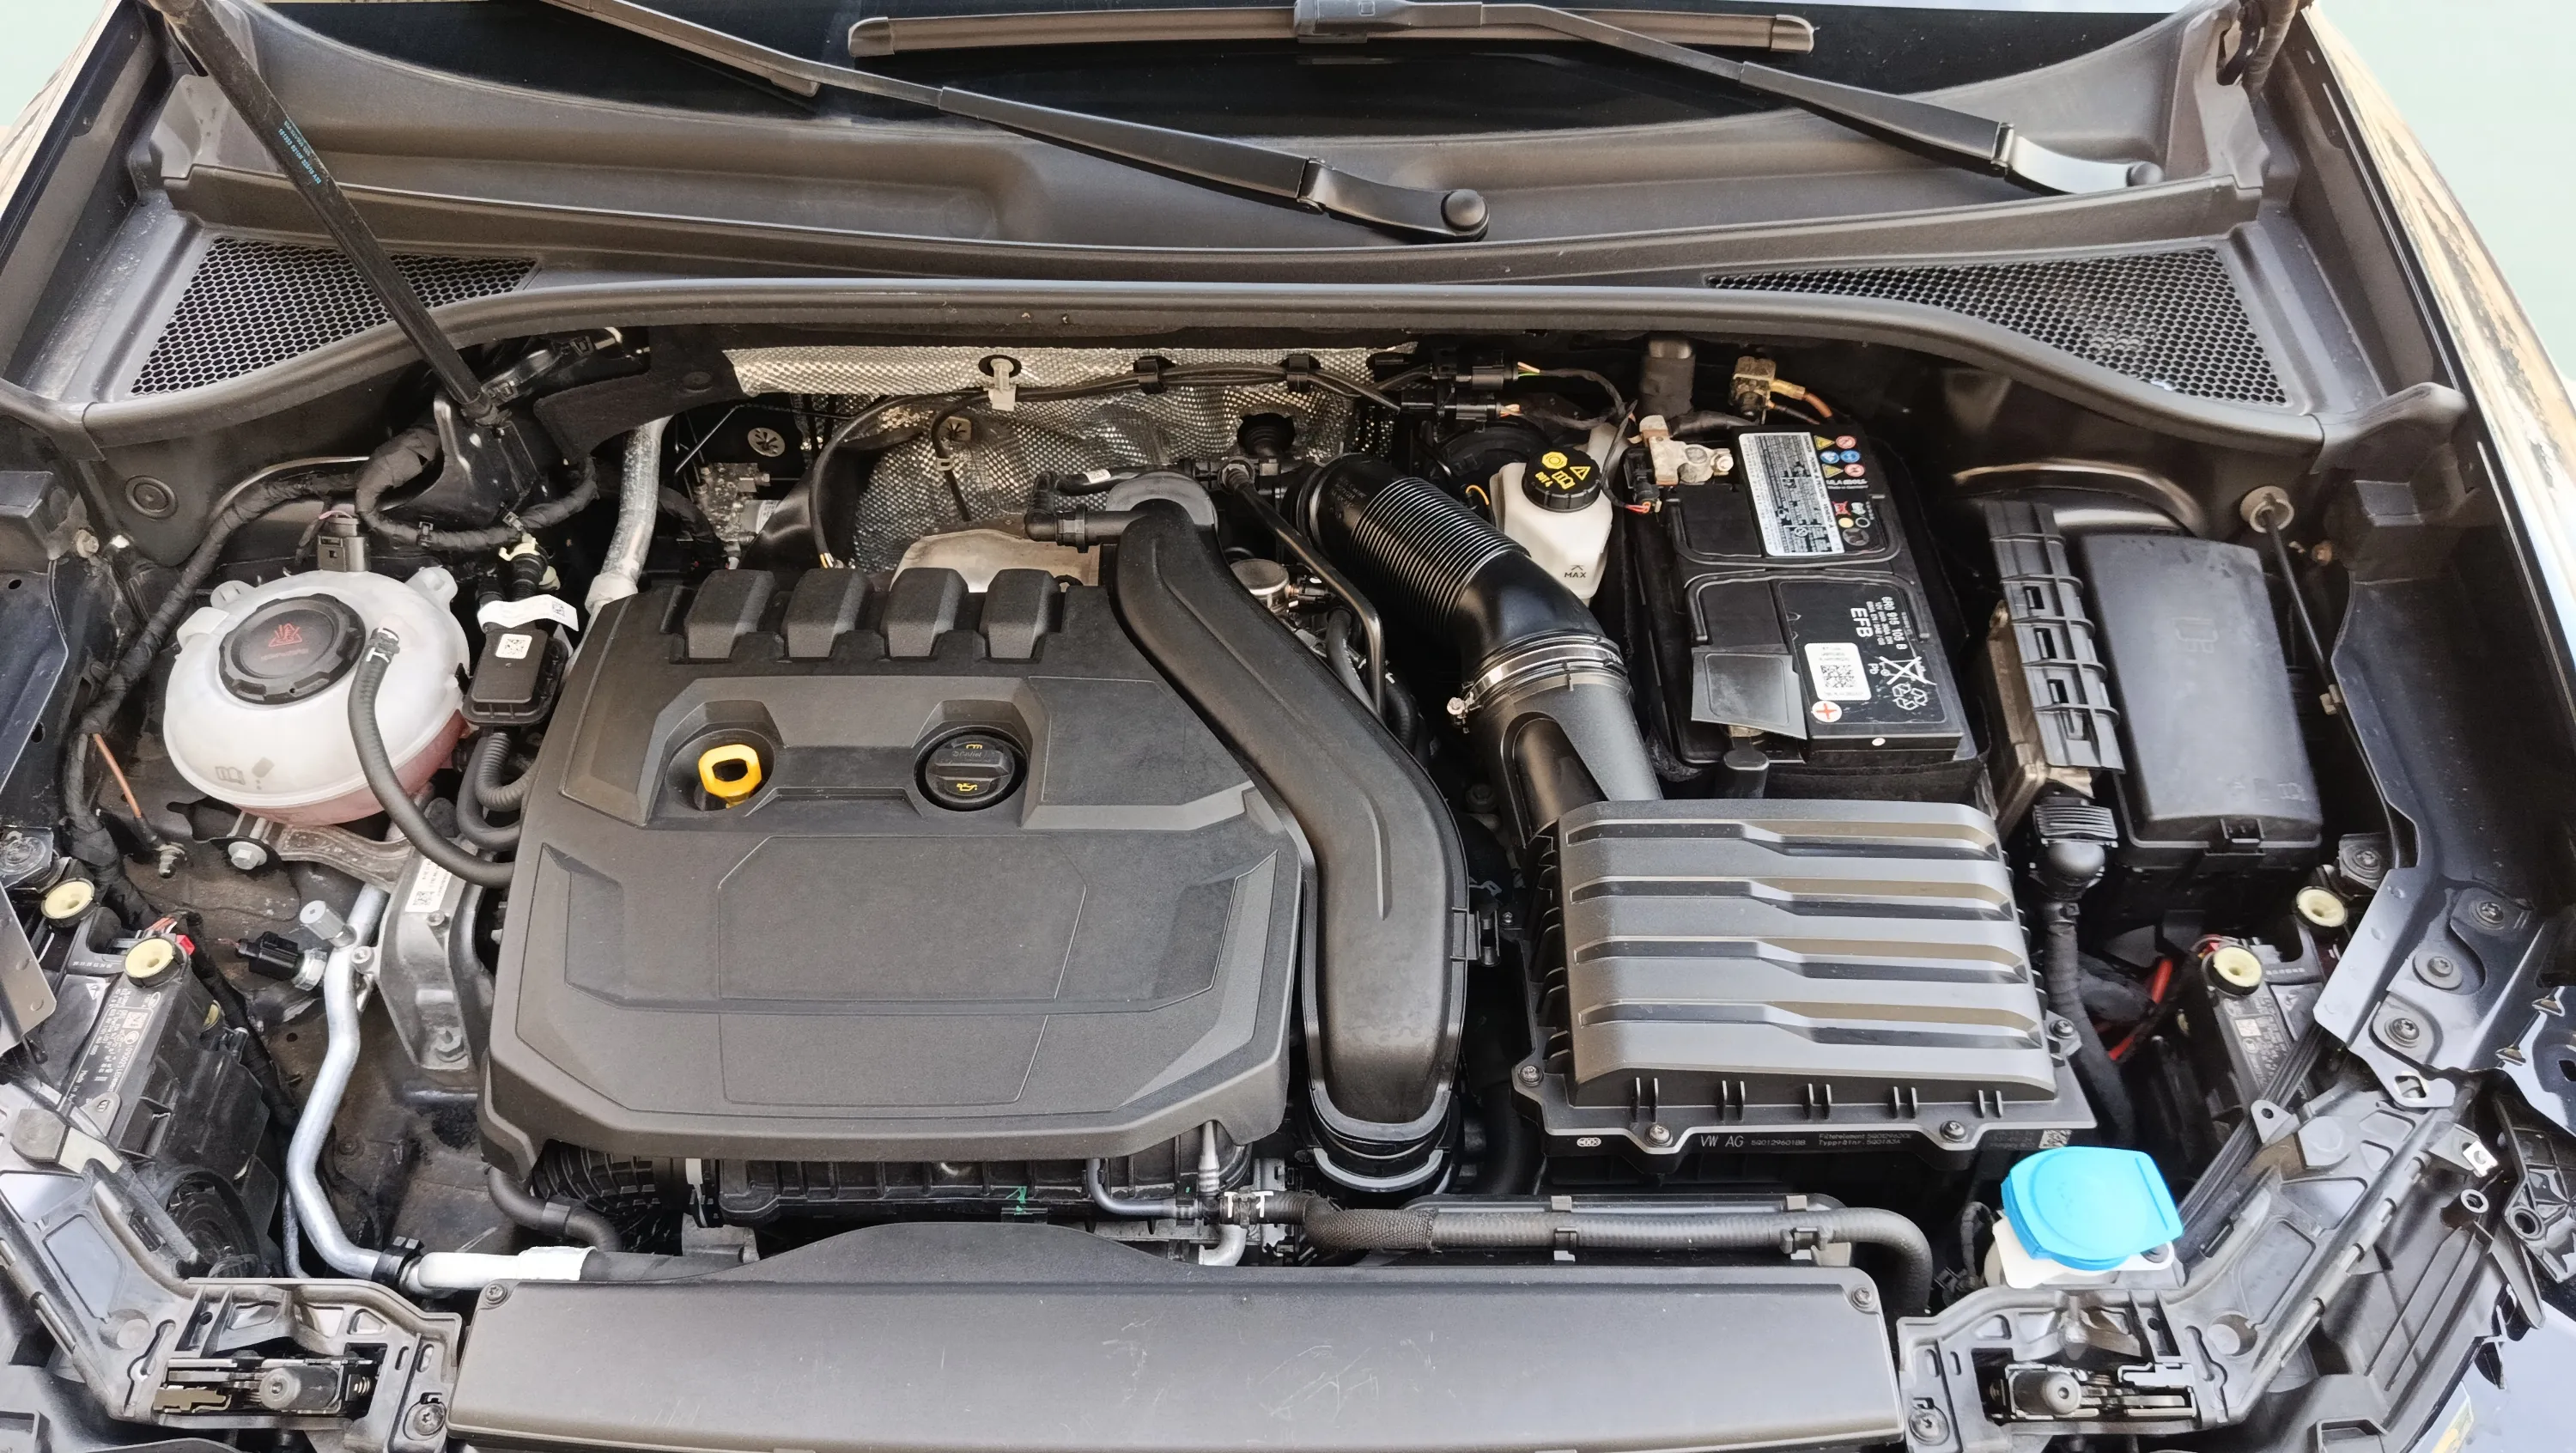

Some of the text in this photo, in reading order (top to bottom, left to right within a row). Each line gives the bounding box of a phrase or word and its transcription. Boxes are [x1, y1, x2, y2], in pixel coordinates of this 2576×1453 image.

[1850, 608, 1874, 637] EFB
[1893, 629, 1905, 641] 105
[1868, 663, 1880, 674] Pb
[1700, 1135, 1718, 1147] VW
[1725, 1135, 1744, 1147] AG
